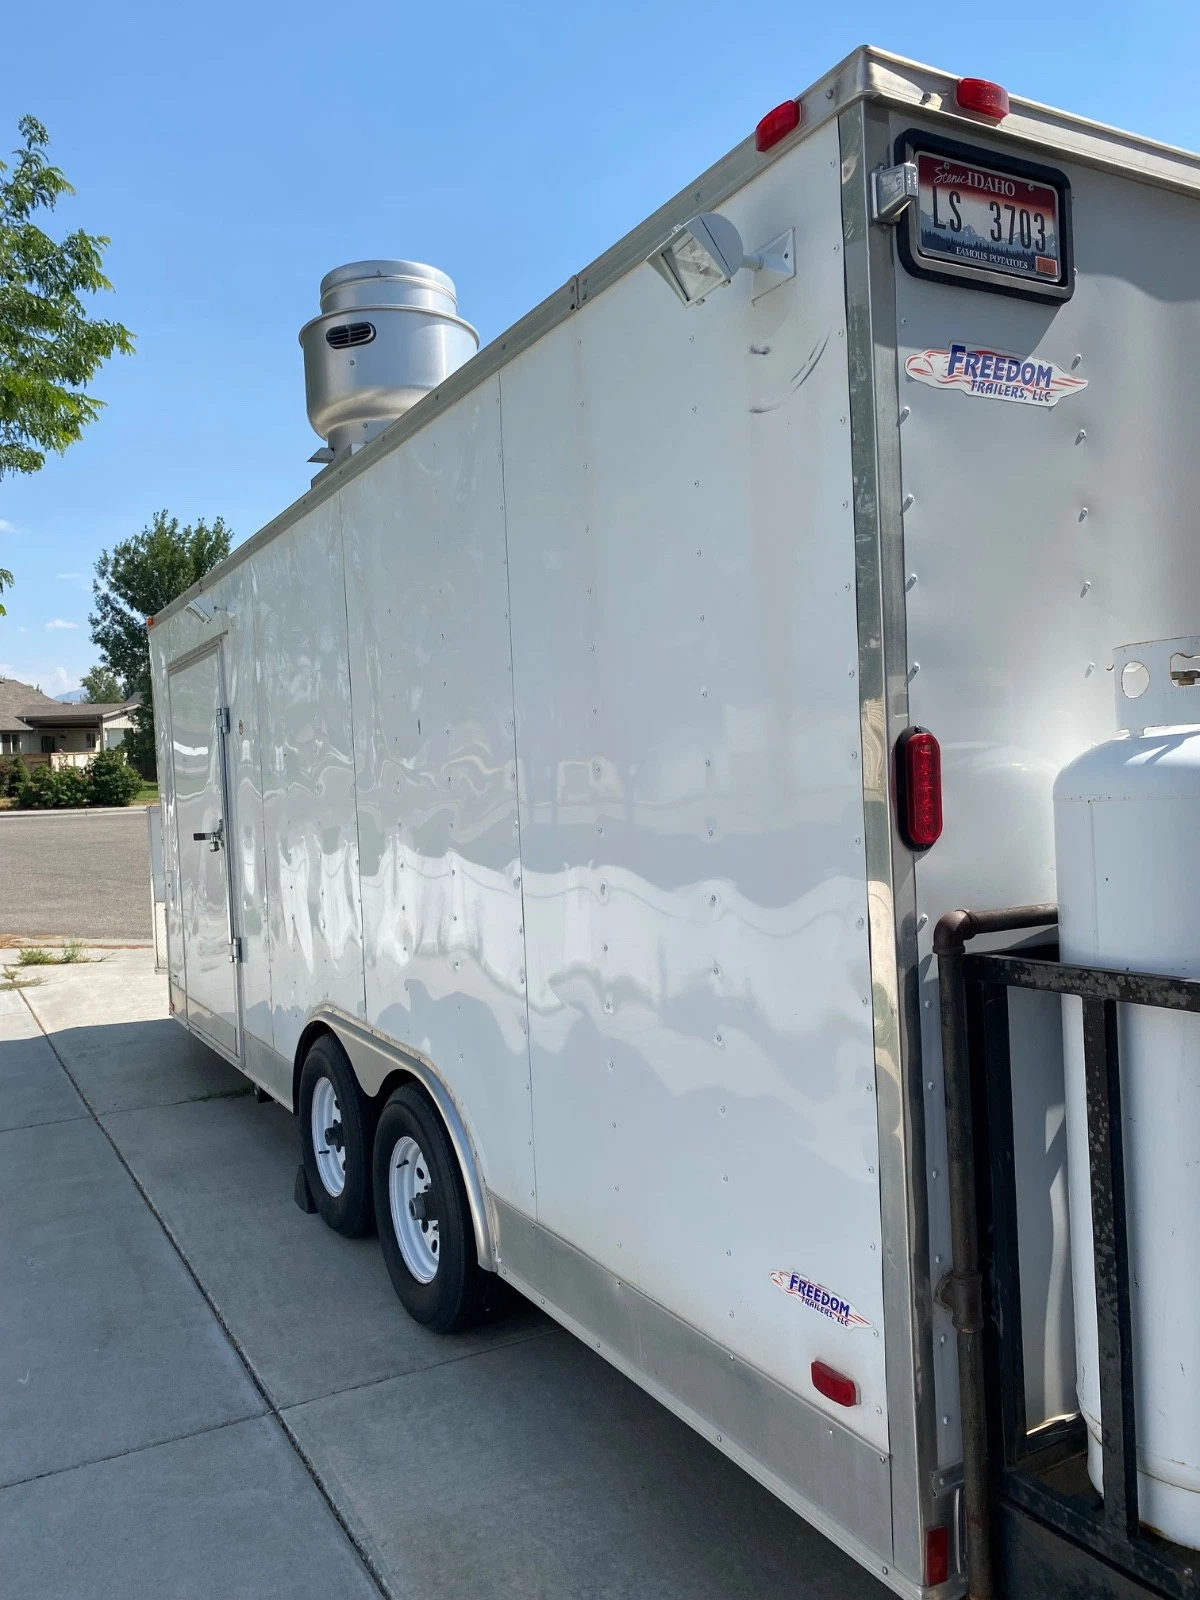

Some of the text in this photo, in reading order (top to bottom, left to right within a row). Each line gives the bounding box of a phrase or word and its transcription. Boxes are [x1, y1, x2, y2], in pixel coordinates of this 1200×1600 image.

[933, 166, 1015, 197] Scenic IDAHO
[932, 185, 1046, 253] LS 3703
[956, 247, 988, 261] FAMOUS
[989, 254, 1028, 269] POTATOES
[948, 344, 1053, 388] FREEDOM
[971, 379, 1051, 402] TRAILERS, LLC
[789, 1274, 850, 1318] FREEDOM
[801, 1296, 850, 1327] TRAILERS, LLC
